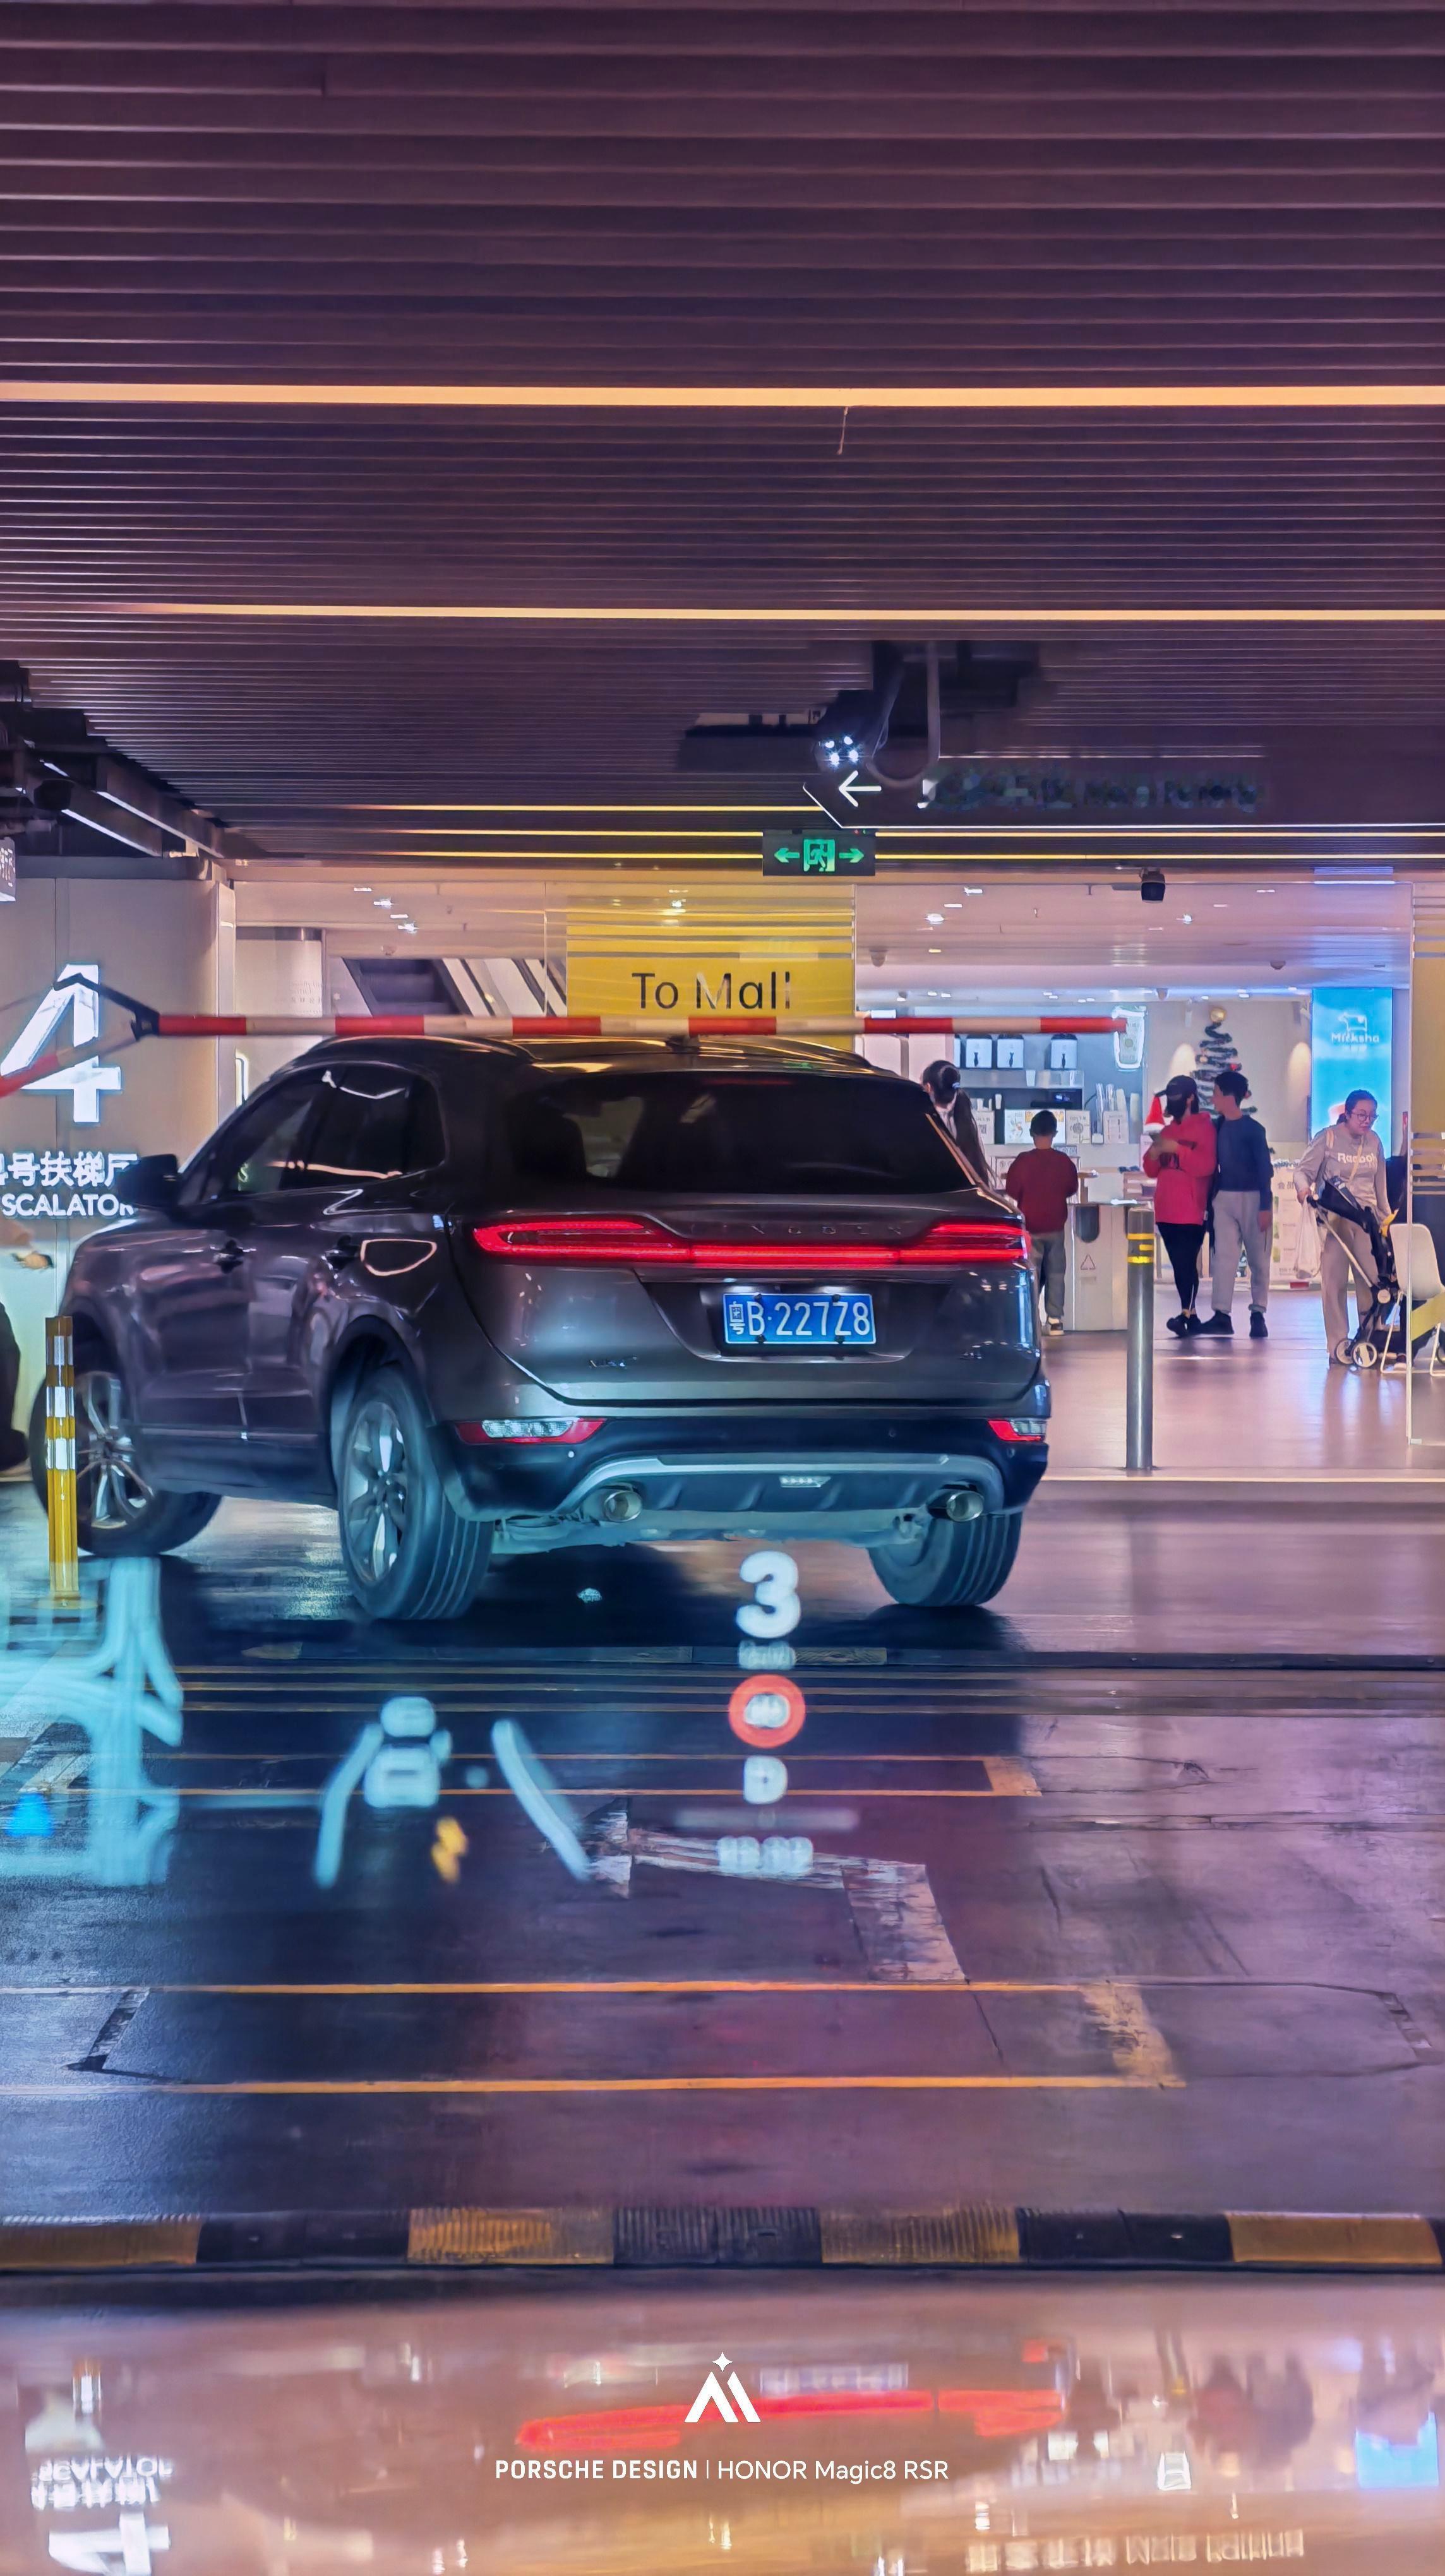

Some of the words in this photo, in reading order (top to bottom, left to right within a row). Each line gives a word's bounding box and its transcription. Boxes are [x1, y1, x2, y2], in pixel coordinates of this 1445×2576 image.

[632, 973, 678, 1009] To
[696, 971, 790, 1009] Mall
[0, 964, 121, 1123] 4
[736, 1551, 801, 1639] 3
